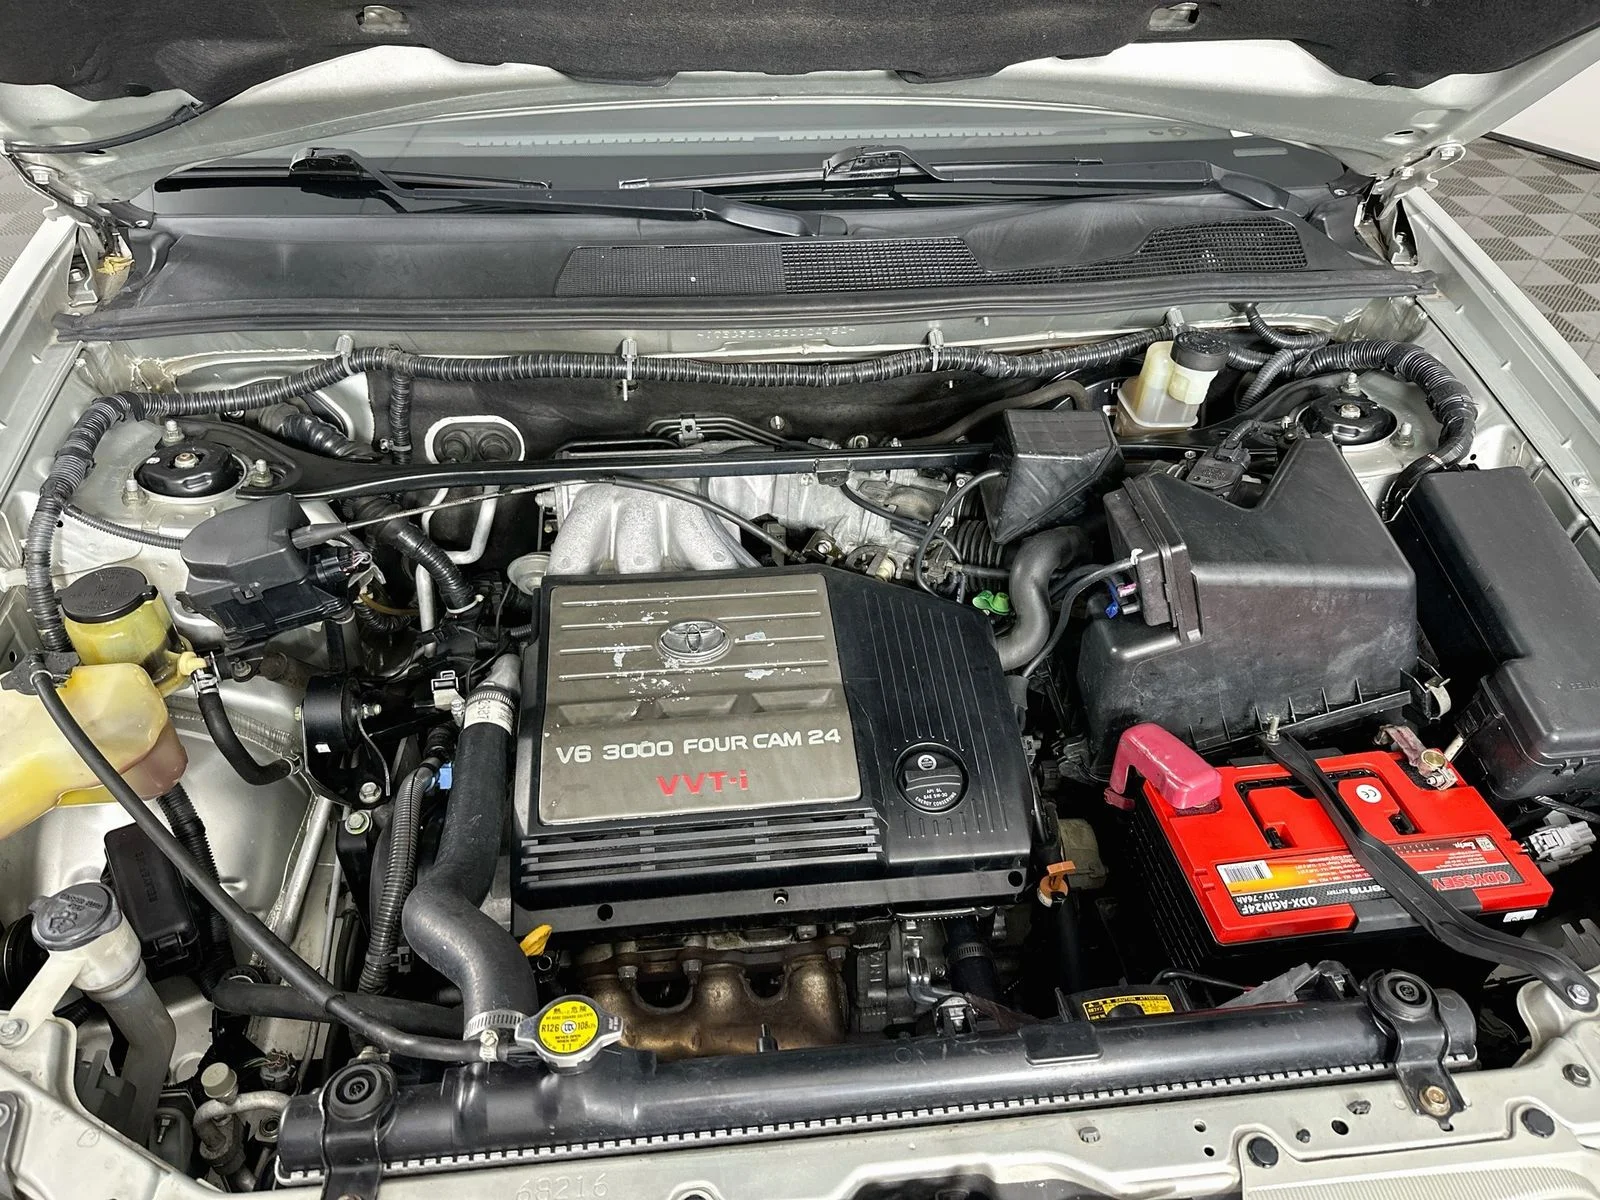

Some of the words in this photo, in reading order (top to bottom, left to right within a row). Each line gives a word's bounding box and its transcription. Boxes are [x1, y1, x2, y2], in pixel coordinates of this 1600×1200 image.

[555, 745, 592, 764] V6
[602, 740, 674, 760] 3000
[683, 735, 748, 754] FOUR
[752, 731, 802, 749] CAM
[807, 728, 841, 745] 24
[656, 769, 749, 796] VVT-i
[1431, 870, 1511, 892] ODYSSEY
[1236, 894, 1257, 903] 76Ah
[1241, 896, 1317, 915] ODX-AGM24F
[1264, 892, 1279, 900] 12V
